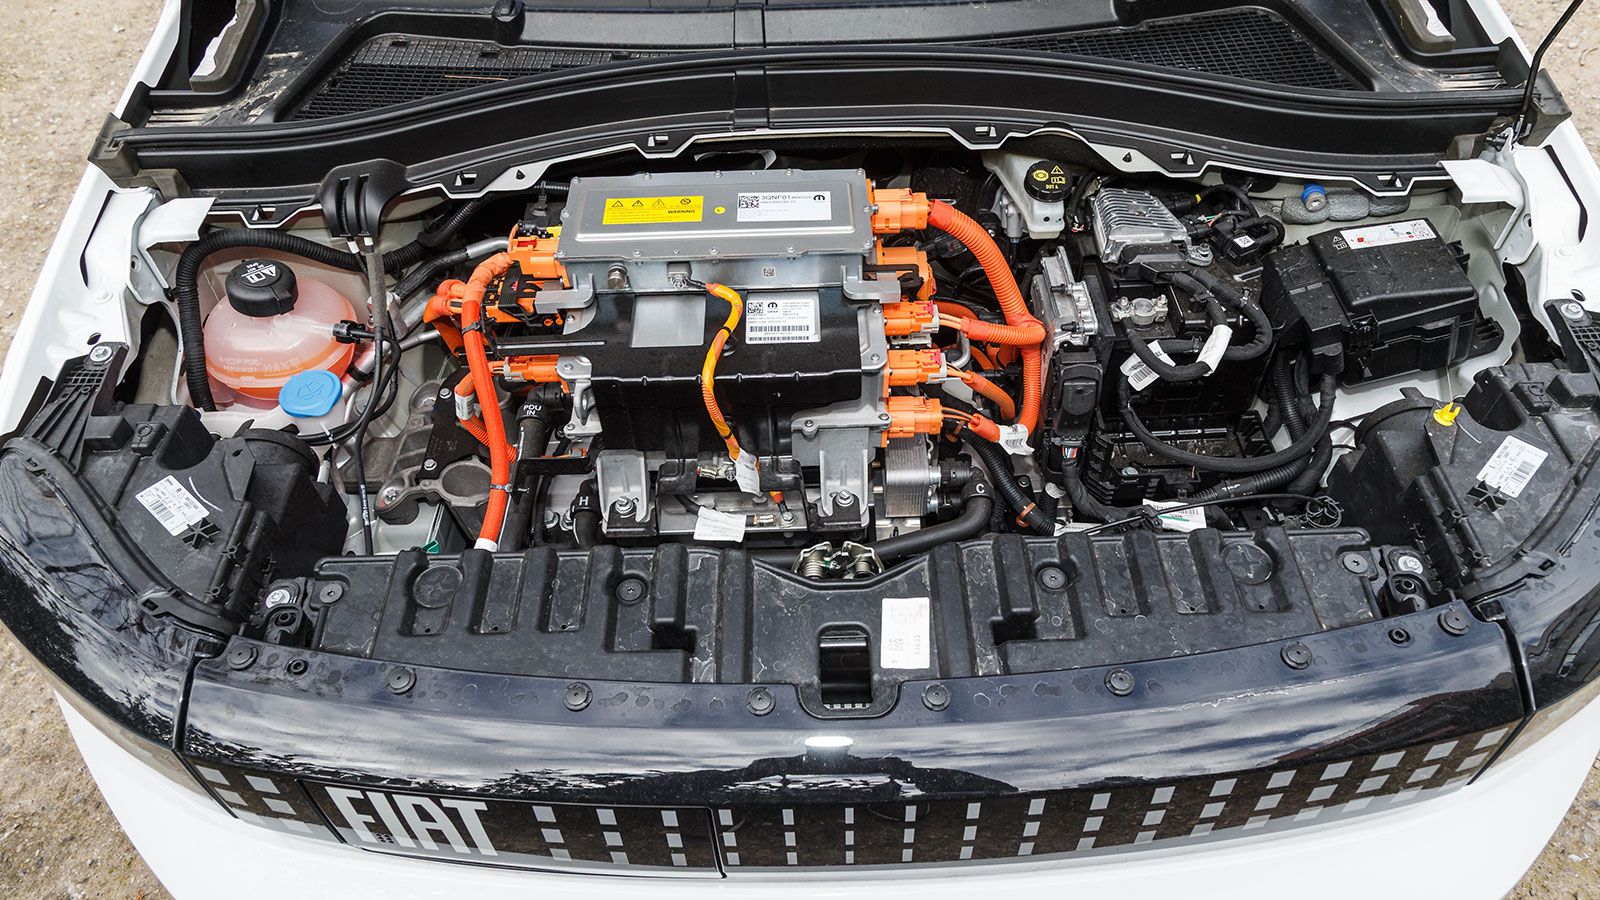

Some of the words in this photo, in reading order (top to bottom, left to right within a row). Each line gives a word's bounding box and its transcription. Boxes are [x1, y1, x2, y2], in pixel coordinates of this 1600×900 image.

[976, 483, 985, 494] C
[579, 496, 589, 506] H
[324, 786, 499, 857] FIAT
